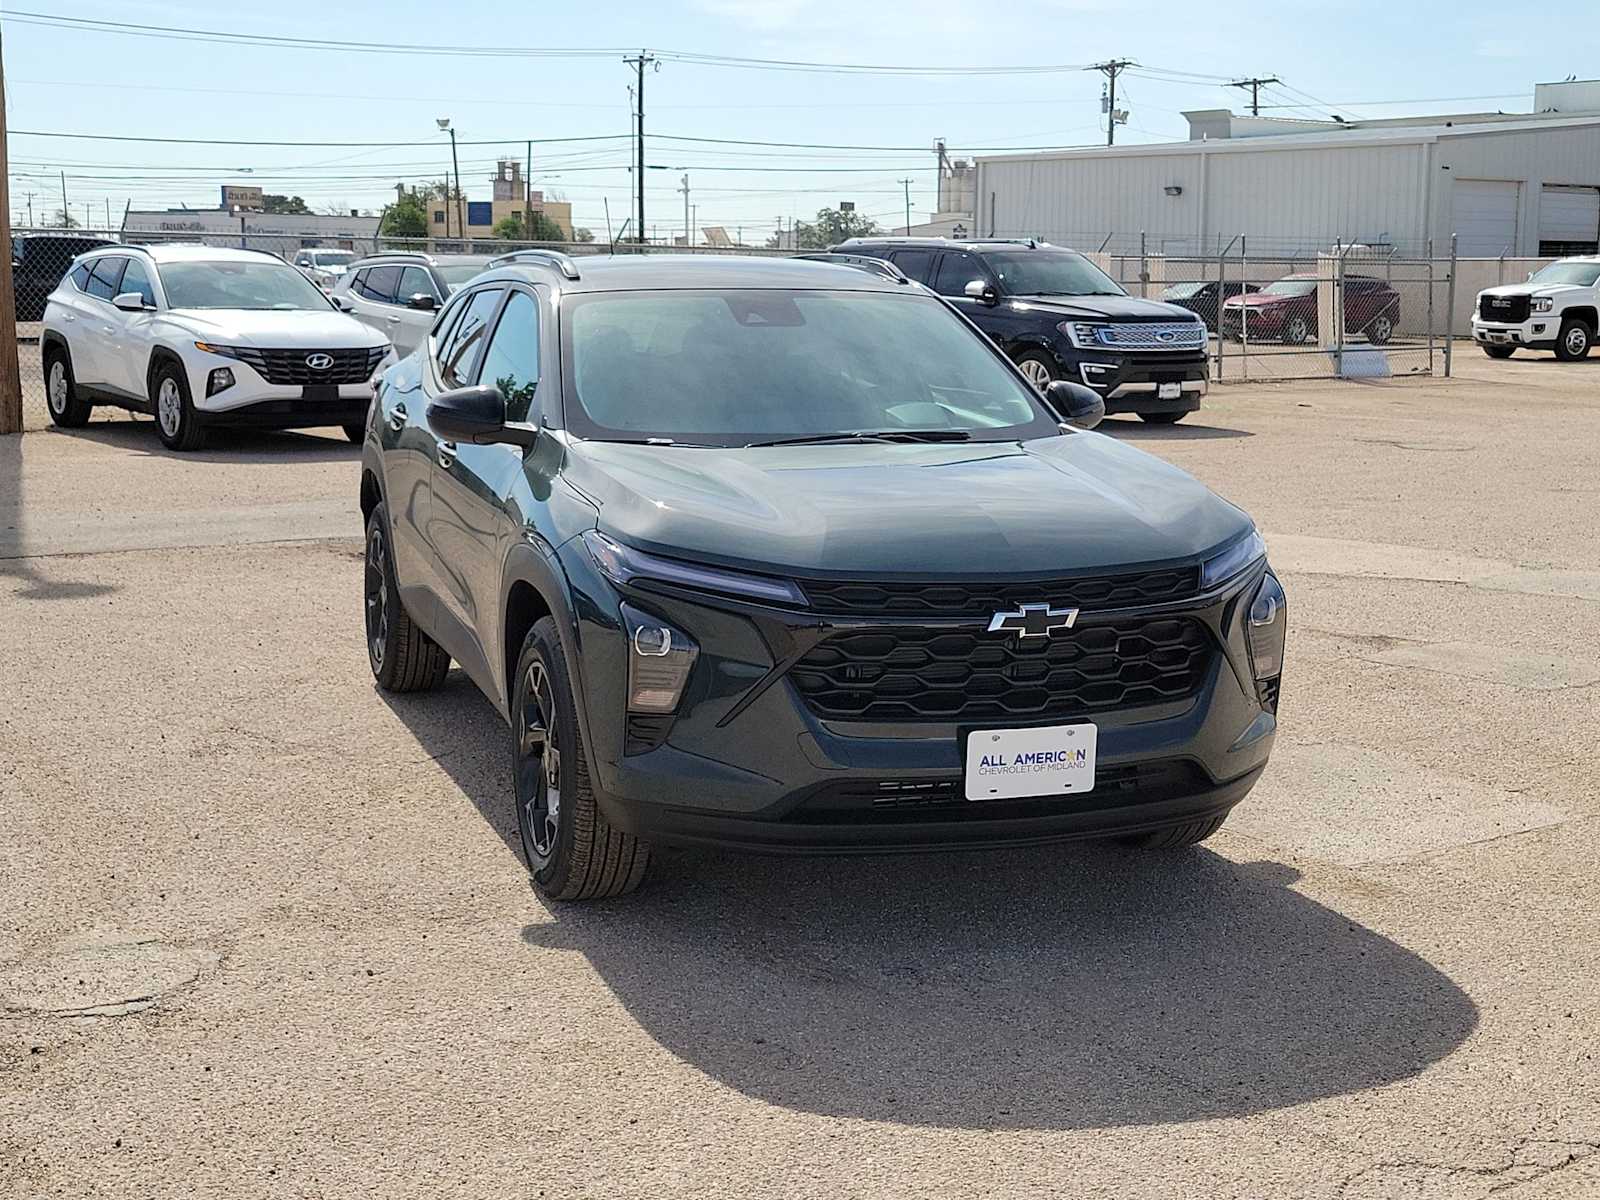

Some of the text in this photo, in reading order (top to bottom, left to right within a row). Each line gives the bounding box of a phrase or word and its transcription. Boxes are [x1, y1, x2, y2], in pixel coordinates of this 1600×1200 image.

[980, 754, 1007, 767] ALL
[978, 761, 1086, 775] CHEVROLET OF MIDLAND
